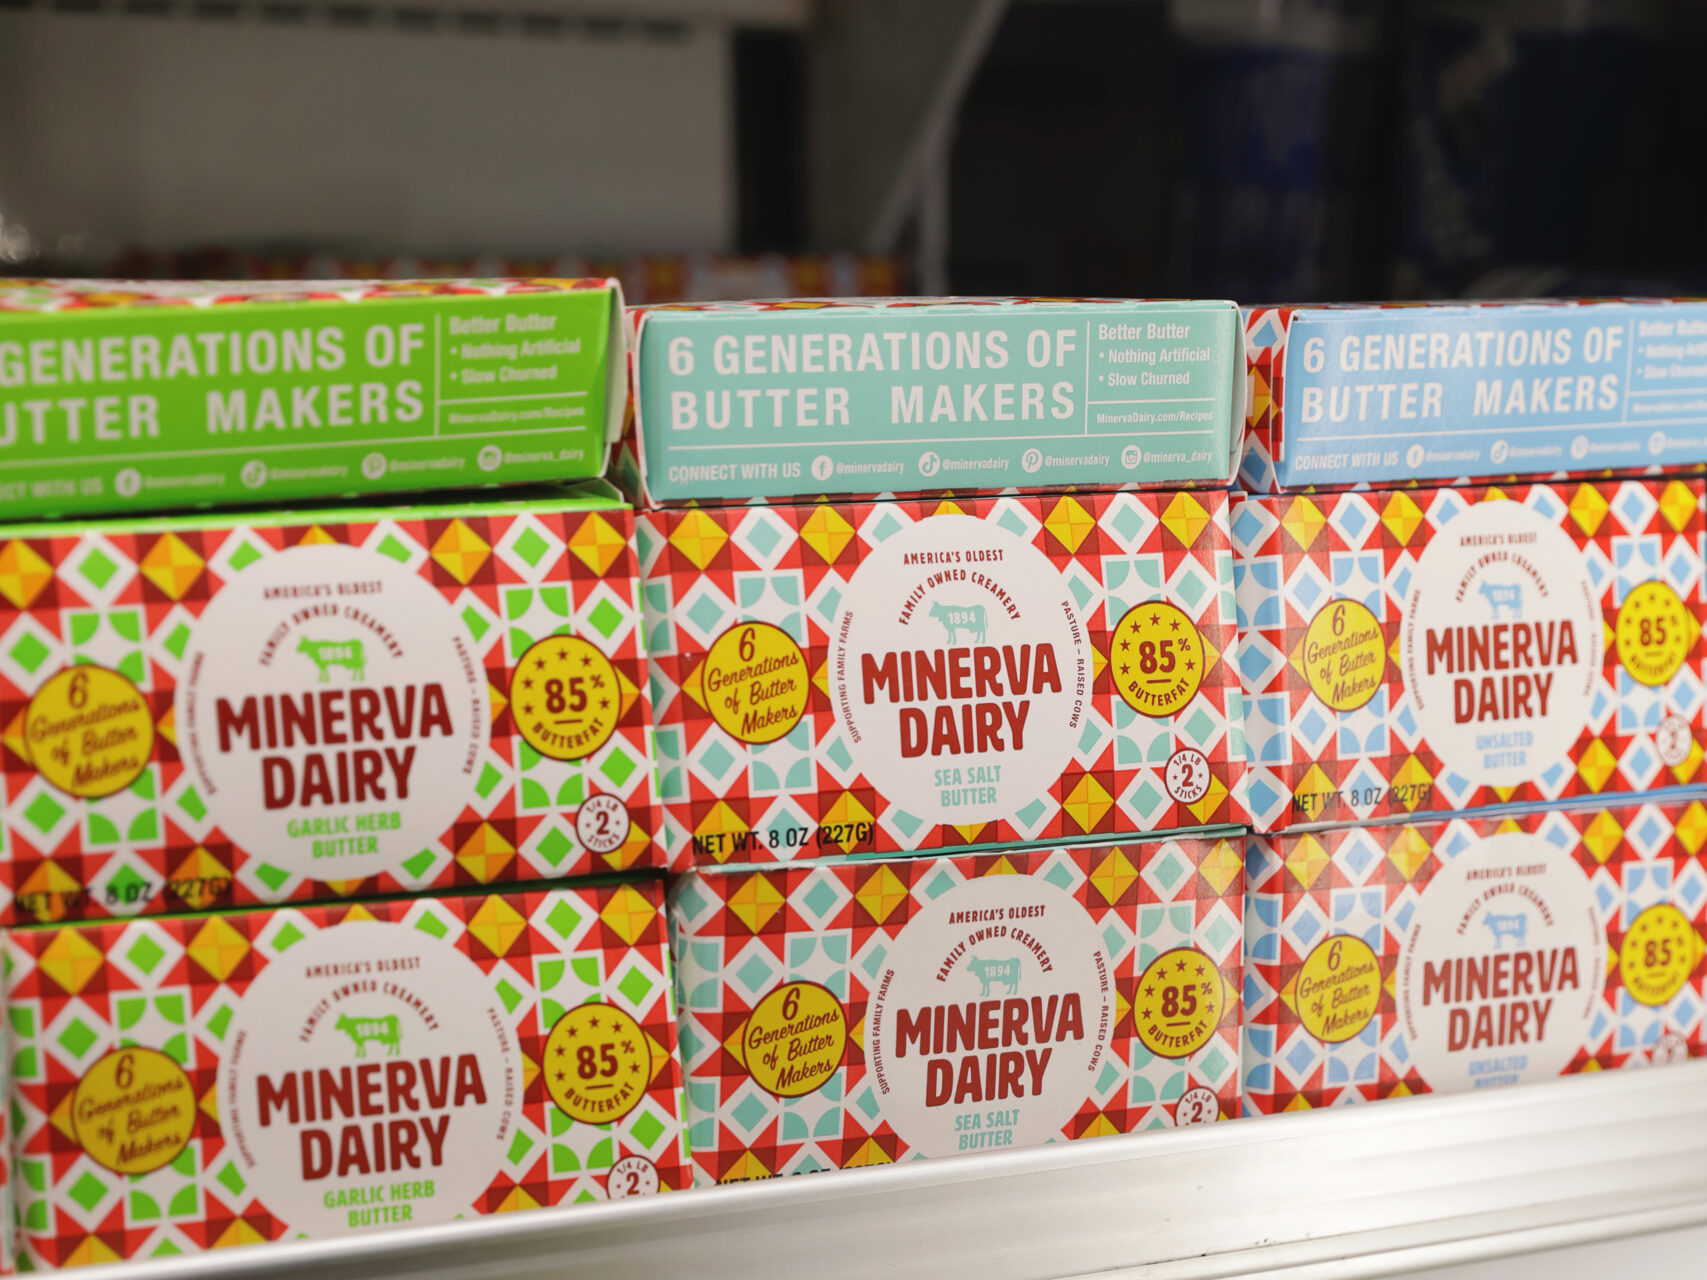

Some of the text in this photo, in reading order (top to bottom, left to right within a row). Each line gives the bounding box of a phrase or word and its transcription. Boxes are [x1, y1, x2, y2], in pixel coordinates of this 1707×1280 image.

[449, 313, 557, 335] Better Butter
[1099, 323, 1191, 340] Better Butter
[0, 323, 425, 387] GENERATIONS OF
[667, 328, 1077, 377] 6 GENERATIONS OF
[1108, 347, 1210, 366] Nothing Artificial
[1303, 326, 1624, 373] 6 GENERATIONS OF
[1108, 371, 1190, 386] Slow Churned
[206, 379, 424, 433] MAKERS
[670, 381, 1076, 431] BUTTER MAKERS
[1301, 374, 1619, 423] BUTTER MAKERS
[1097, 411, 1213, 424] MinervaDairy.com/Recipes
[668, 461, 801, 483] CONNECT WITH US
[1295, 450, 1399, 470] CONNECT WITH US
[903, 549, 1004, 565] AMERICA'S OLDEST
[899, 569, 1021, 625] FAMILY OWNED CREAMERY
[947, 611, 976, 624] 1894
[1332, 604, 1346, 636] 6
[739, 627, 755, 662] 6
[1139, 638, 1191, 674] 85%
[1307, 628, 1379, 664] Generations
[1426, 620, 1578, 675] MINERVA
[708, 652, 799, 692] Generations
[838, 610, 861, 743] SUPPORTING FAMILY FARMS
[861, 643, 1062, 705] MINERVA
[1062, 601, 1085, 729] PASTURE RAISED COWS
[1320, 650, 1377, 686] of Butter
[68, 671, 90, 710] 6
[544, 674, 605, 714] 85%
[725, 678, 796, 714] of Butter
[1128, 677, 1190, 707] BUTTERFAT
[1332, 677, 1376, 704] Makers
[1454, 672, 1554, 724] DAIRY
[216, 683, 454, 753] MINERVA
[532, 717, 605, 749] BUTTERFAT
[741, 704, 798, 737] Makers
[899, 700, 1030, 758] DAIRY
[1476, 731, 1533, 751] UNSALTED
[934, 765, 1001, 786] SEA SALT
[1173, 753, 1201, 767] 1/4 LB
[1181, 764, 1193, 787] 2
[1483, 751, 1526, 769] BUTTER
[262, 745, 416, 810] DAIRY
[1174, 784, 1203, 800] STICKS
[941, 787, 997, 807] BUTTER
[1291, 782, 1432, 812] NET WT. 8 OZ (227G)
[287, 812, 402, 838] GARLIC HERB
[595, 810, 611, 836] 2
[692, 822, 874, 854] NET WT. 8 OZ (227G)
[312, 836, 378, 858] BUTTER
[949, 905, 1046, 924] AMERICA'S OLDEST
[936, 926, 1053, 983] FAMILY OWNED CREAMERY
[984, 965, 1011, 977] 1894
[1328, 940, 1342, 971] 6
[1300, 960, 1375, 999] Generations
[1423, 947, 1578, 1006] MINERVA
[782, 987, 800, 1021] 6
[1088, 951, 1109, 1072] PASTURE RAISED COWS
[1161, 982, 1213, 1018] 85%
[1311, 983, 1371, 1018] of Butter
[748, 1009, 840, 1050] Generations
[873, 969, 895, 1095] SUPPORTING FAMILY FARMS
[895, 993, 1084, 1058] MINERVA
[1148, 1020, 1208, 1048] BUTTERFAT
[1322, 1007, 1369, 1037] Makers
[1448, 998, 1553, 1053] DAIRY
[576, 1040, 635, 1080] 85%
[763, 1034, 835, 1070] of Butter
[115, 1053, 135, 1089] 6
[776, 1058, 833, 1091] Makers
[925, 1048, 1053, 1108] DAIRY
[77, 1077, 184, 1123] Generations
[256, 1054, 487, 1127] MINERVA
[564, 1081, 635, 1113] BUTTERFAT
[955, 1109, 1020, 1131] SEA SALT
[1190, 1101, 1203, 1123] 2
[116, 1133, 182, 1167] Makers
[300, 1115, 451, 1181] DAIRY
[958, 1130, 1013, 1150] BUTTER
[323, 1180, 435, 1209] GARLIC HERB
[626, 1172, 640, 1196] 2
[348, 1204, 412, 1228] BUTTER
